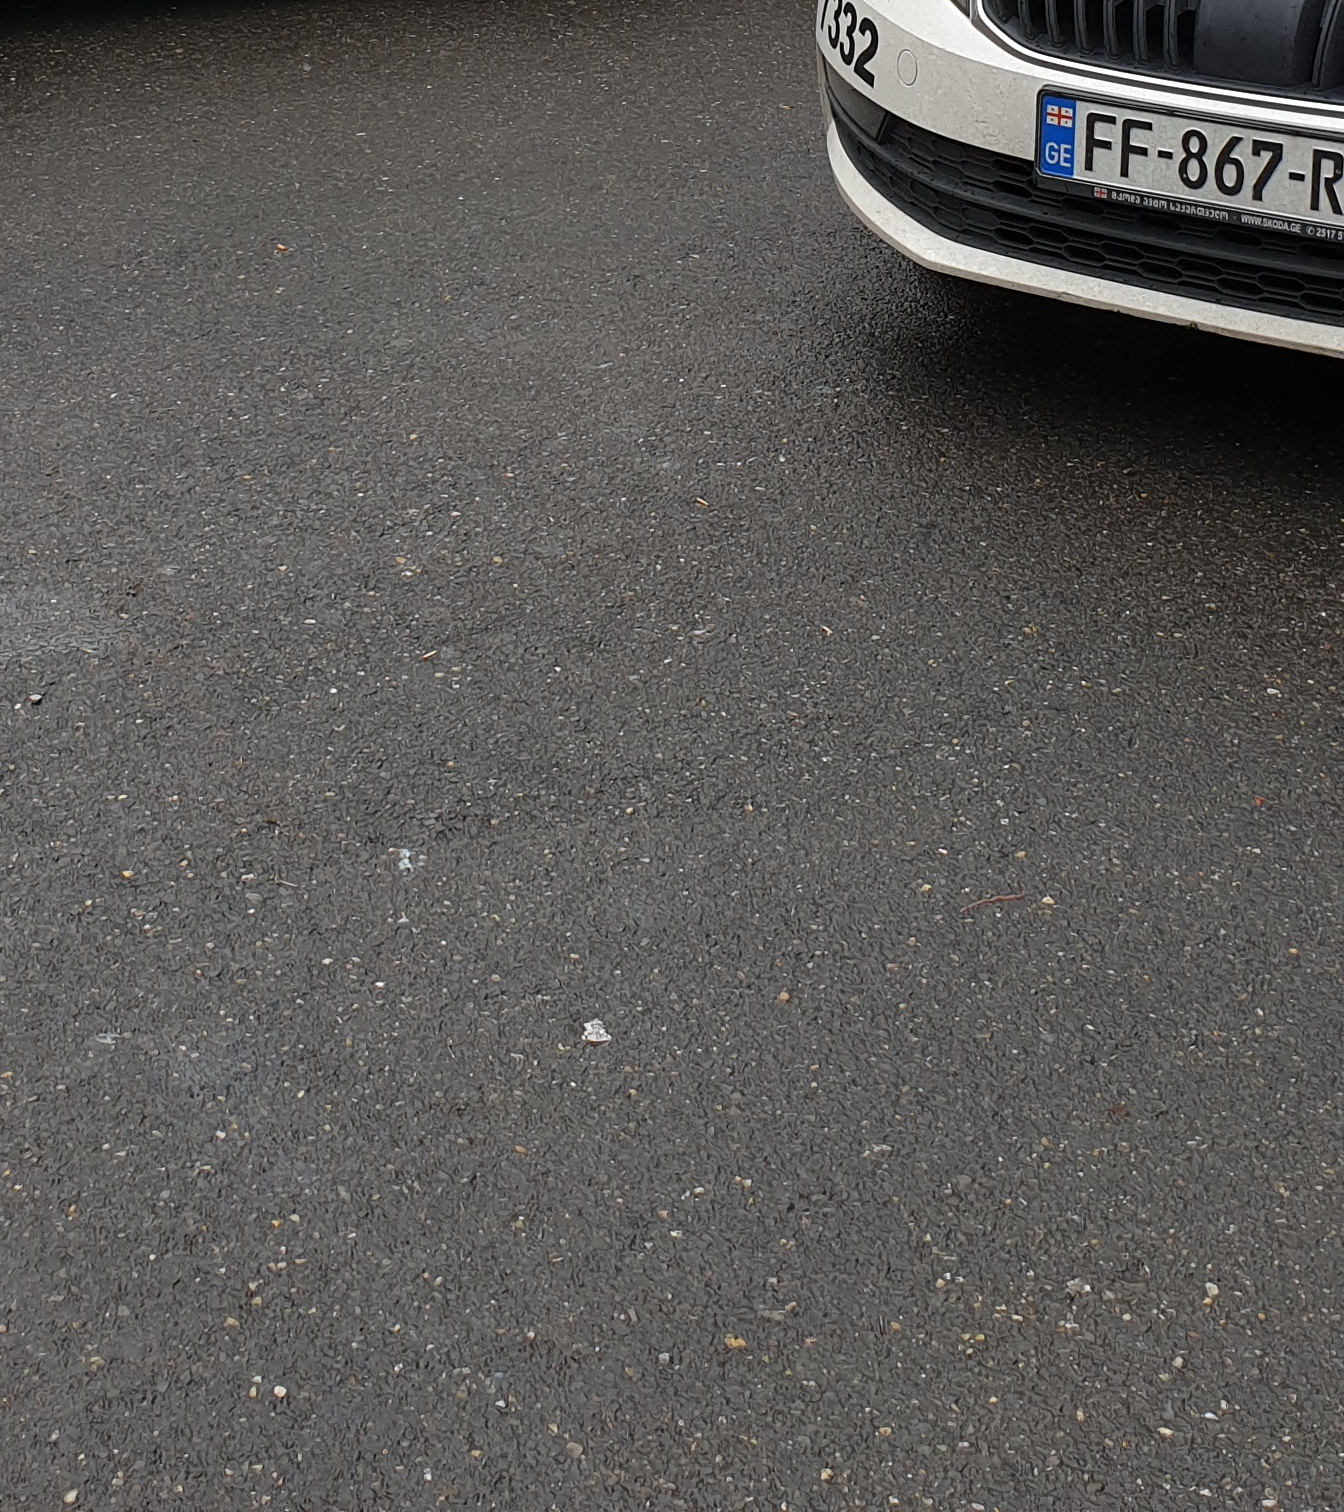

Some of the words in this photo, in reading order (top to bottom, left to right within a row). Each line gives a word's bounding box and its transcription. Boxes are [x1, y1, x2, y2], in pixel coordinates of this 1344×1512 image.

[1044, 141, 1072, 169] GE
[1240, 213, 1302, 234] WWW.SKODA.GE
[1316, 227, 1336, 239] 2517
